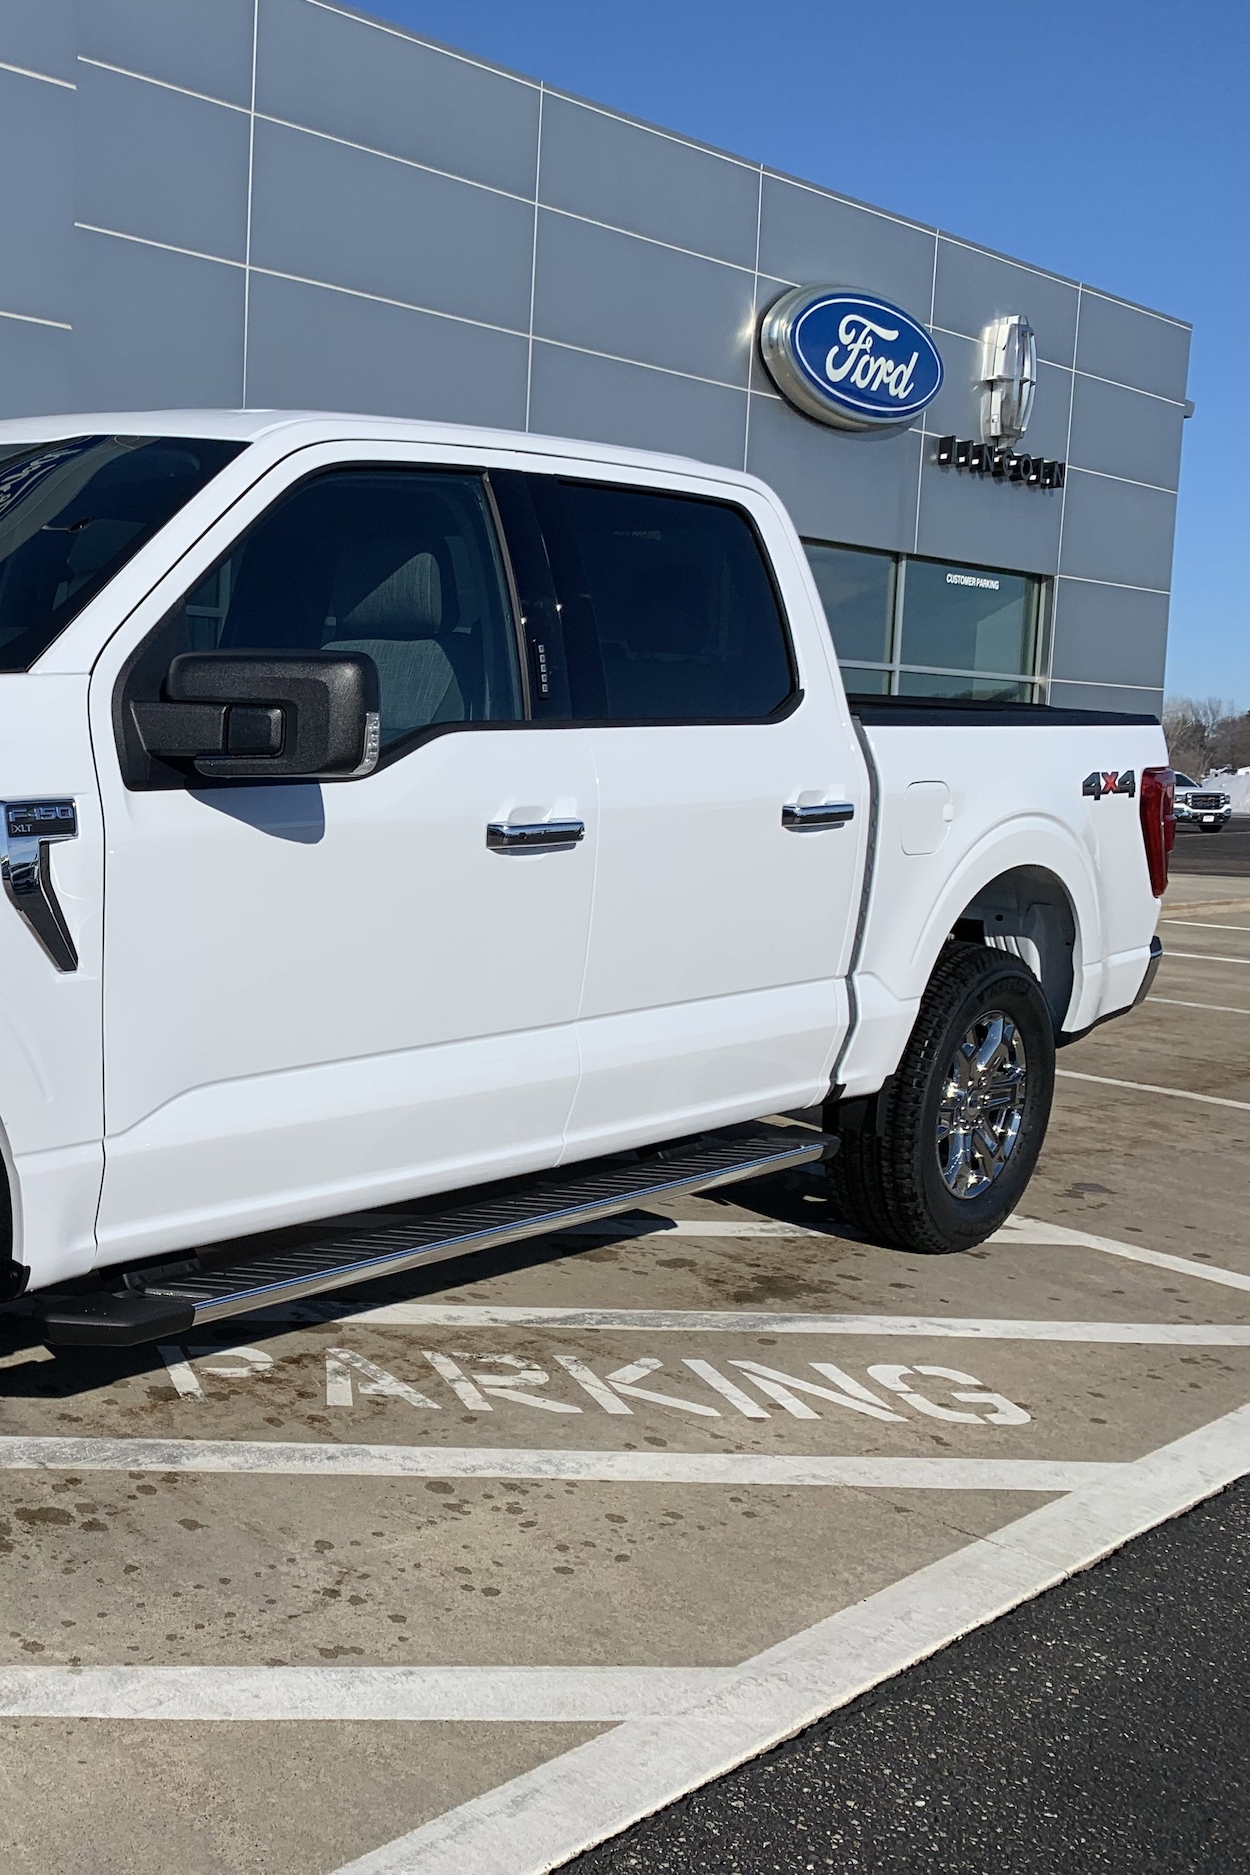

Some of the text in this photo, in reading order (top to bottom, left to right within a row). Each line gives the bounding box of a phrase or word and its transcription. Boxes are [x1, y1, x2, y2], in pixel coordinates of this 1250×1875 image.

[825, 314, 919, 400] Ford
[946, 573, 1000, 590] CUSTOMER PARKING
[8, 806, 74, 823] F-150
[13, 823, 32, 833] XLT
[155, 1344, 1033, 1427] PARKING
